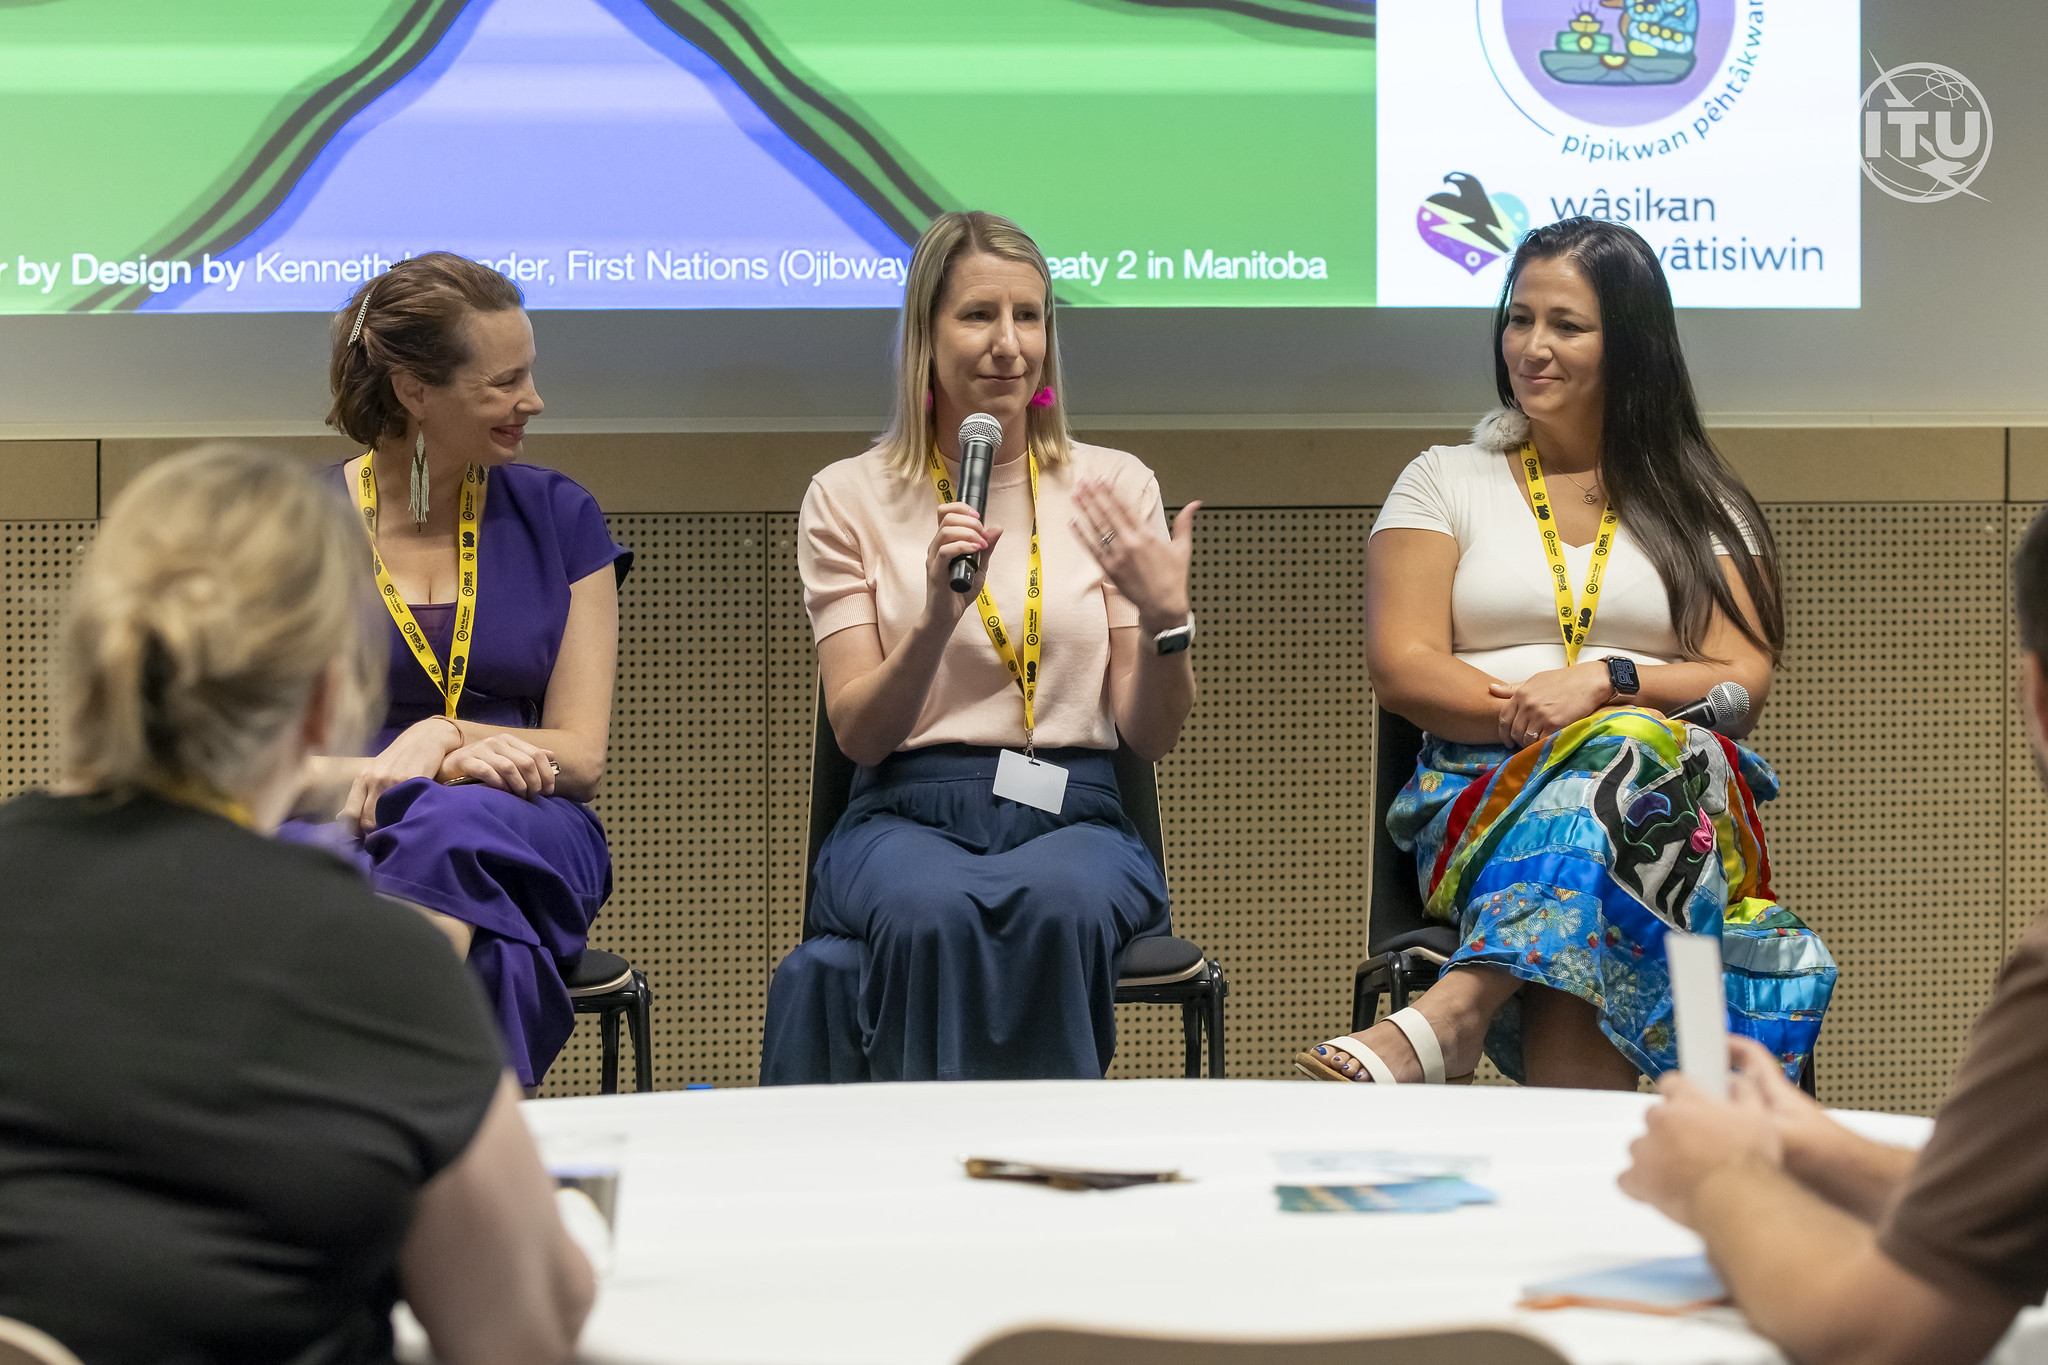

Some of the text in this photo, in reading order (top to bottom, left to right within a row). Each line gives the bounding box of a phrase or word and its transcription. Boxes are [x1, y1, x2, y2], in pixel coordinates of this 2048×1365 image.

[1562, 132, 1688, 163] pipikwan
[1549, 188, 1716, 222] wâsikan
[17, 255, 61, 294] by
[71, 252, 192, 293] Design
[202, 252, 245, 292] by
[256, 250, 391, 283] Kenneth
[567, 249, 636, 281] First
[646, 249, 769, 281] Nations
[1116, 249, 1138, 280] 2
[1147, 249, 1174, 280] in
[1183, 248, 1328, 280] Manitoba
[1659, 237, 1824, 271] âtisiwin
